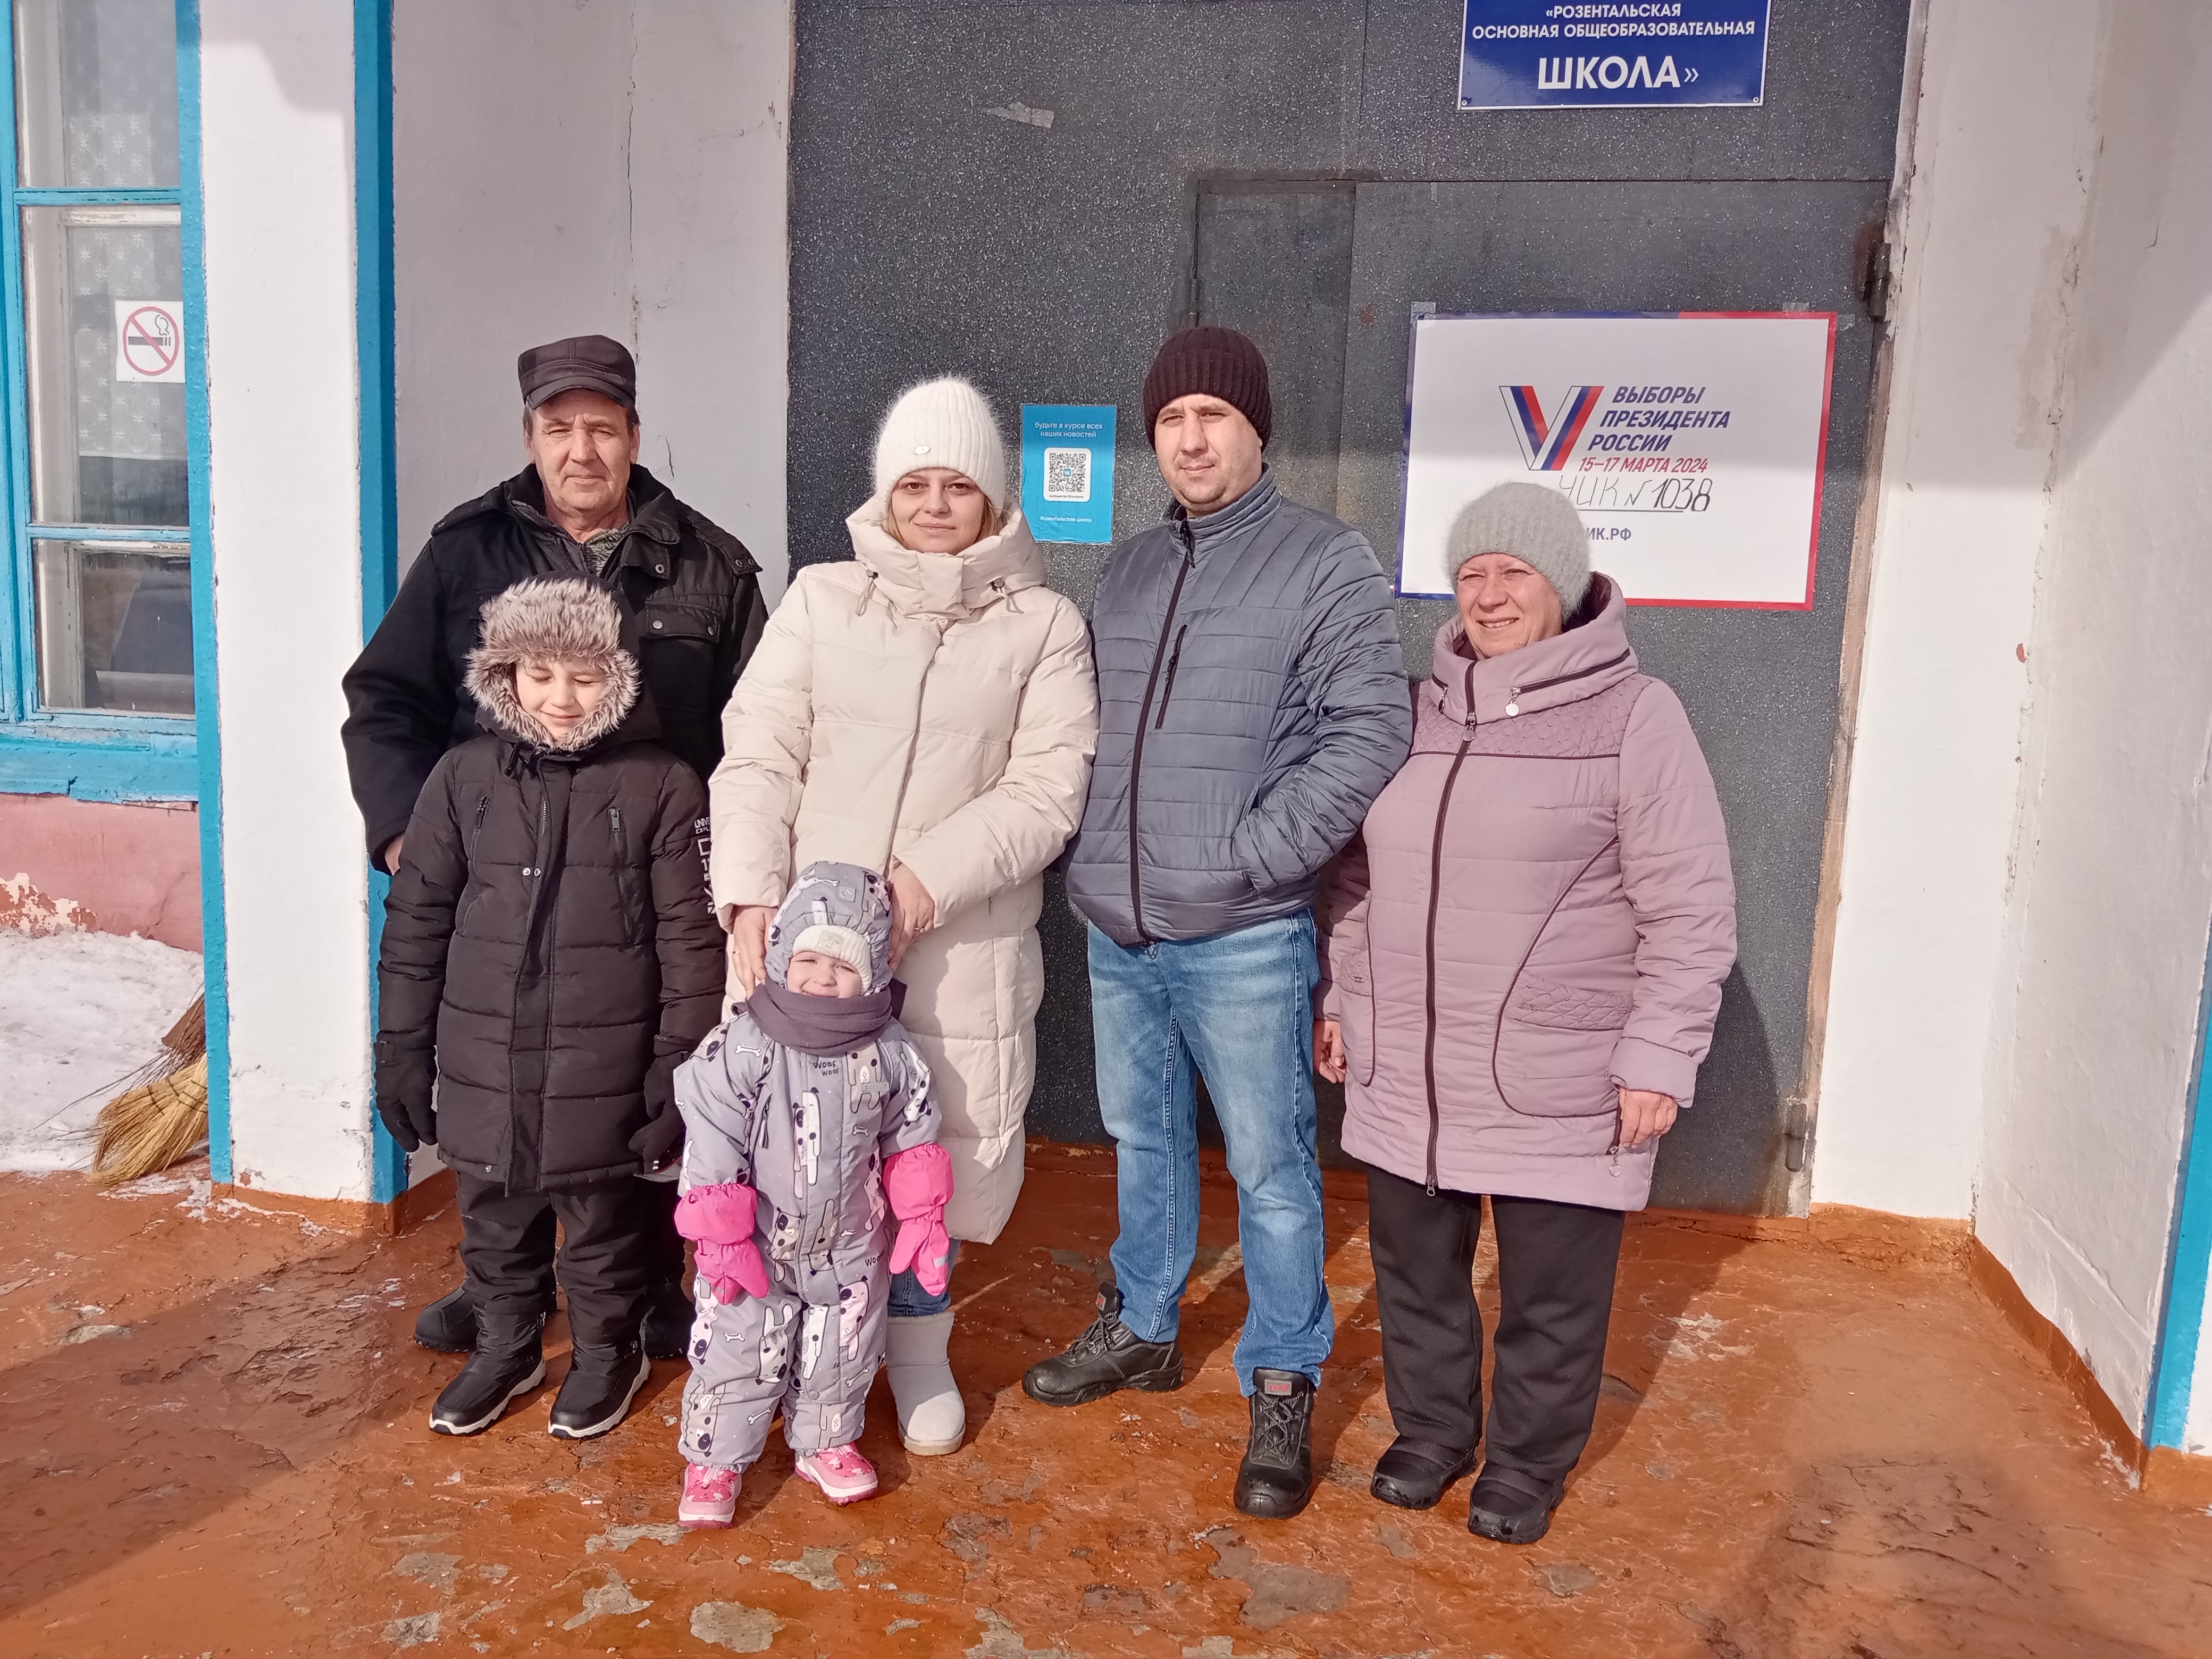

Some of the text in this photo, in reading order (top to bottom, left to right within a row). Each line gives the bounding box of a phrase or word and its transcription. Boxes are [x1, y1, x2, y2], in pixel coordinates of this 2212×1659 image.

[1546, 3, 1681, 19] «РОЗЕНТАЛЬСКАЯ
[1472, 21, 1755, 39] ОСНОВНАЯ ОБЩЕОБРАЗОВАТЕЛЬНАЯ
[1538, 55, 1699, 89] ШКОЛА»
[1611, 386, 1706, 404] ВЫБОРЫ
[1034, 421, 1058, 430] будьте
[1599, 410, 1731, 431] ПРЕЗИДЕНТА
[1587, 434, 1673, 452] РОССИИ
[1619, 457, 1671, 473] МАРТА
[1671, 457, 1708, 473] 2024
[1652, 478, 1713, 512] 1038
[1586, 527, 1631, 541] ИК.РФ
[694, 817, 710, 828] UNIVE
[696, 826, 710, 834] EXPL
[814, 1060, 837, 1069] WOOF
